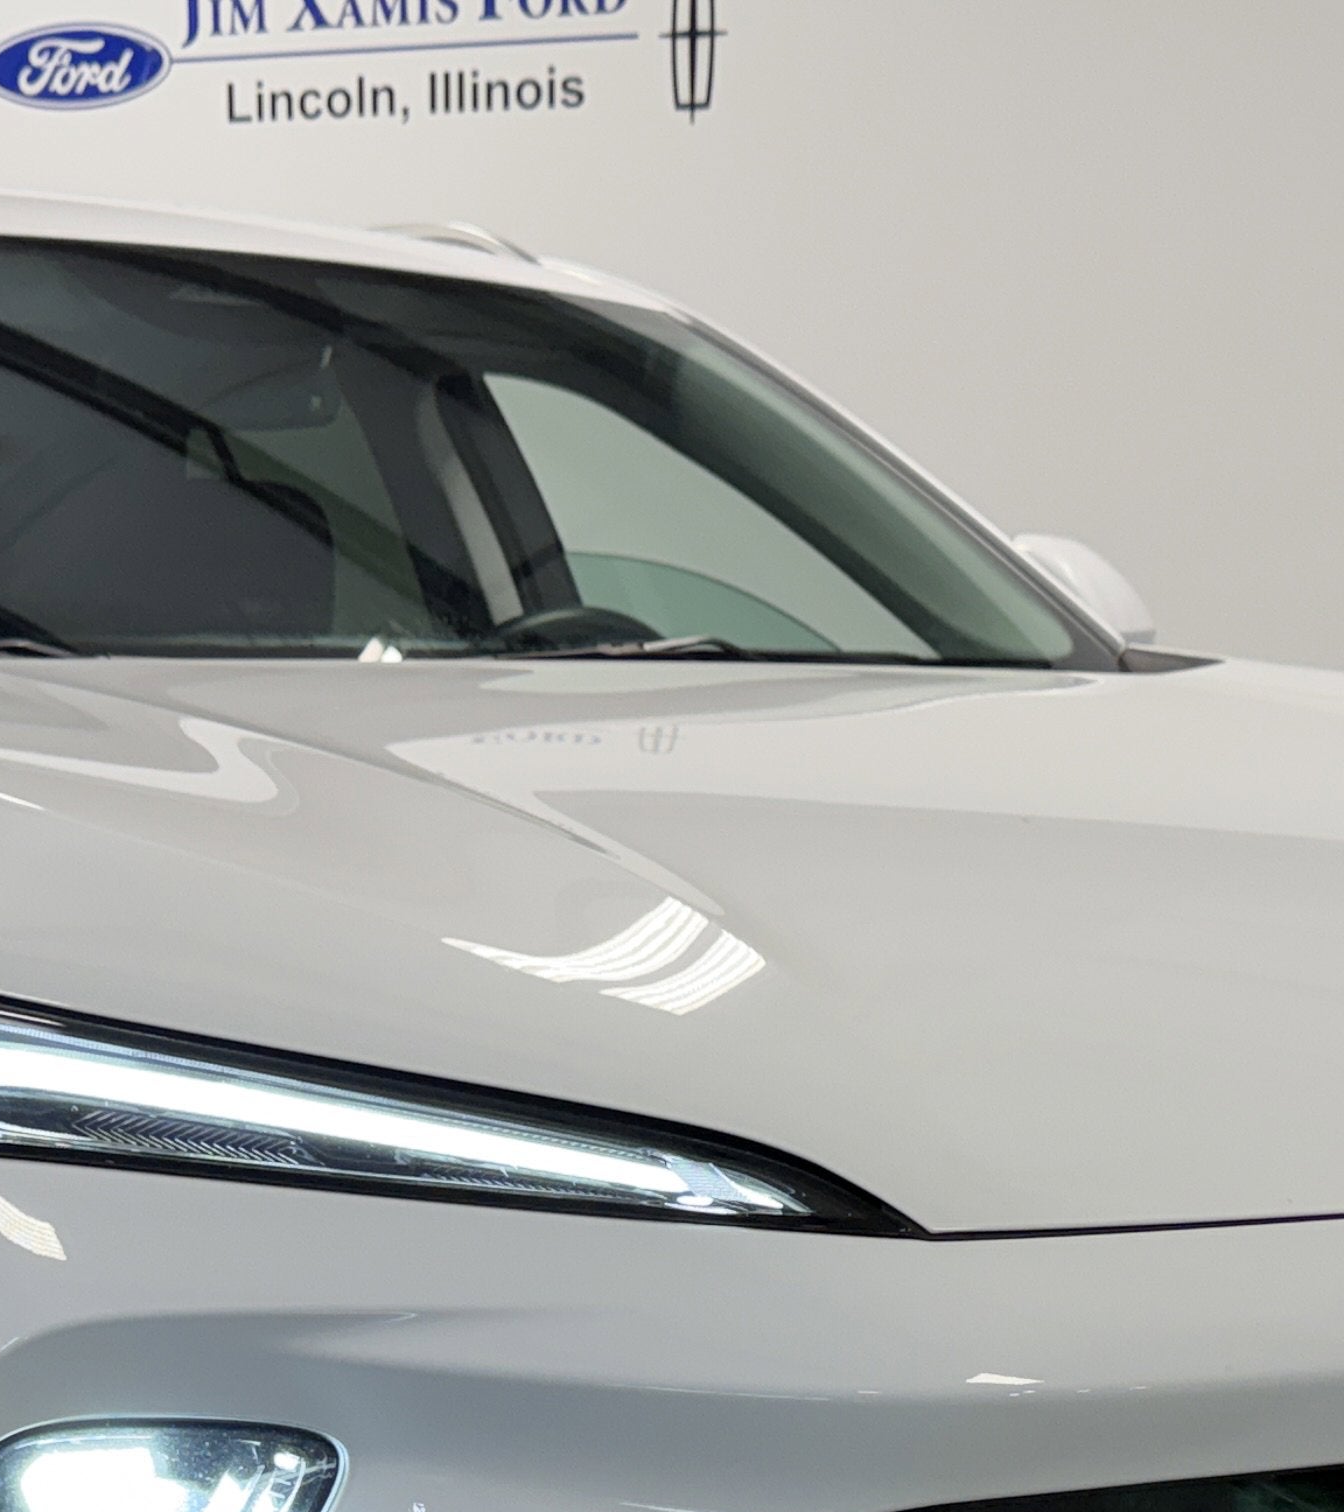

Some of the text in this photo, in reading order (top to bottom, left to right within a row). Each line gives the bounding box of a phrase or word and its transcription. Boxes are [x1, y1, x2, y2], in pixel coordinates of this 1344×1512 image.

[182, 0, 268, 48] JIM
[286, 0, 459, 33] XAMIS
[17, 37, 134, 97] Ford
[227, 64, 586, 124] Lincoln, Illinois
